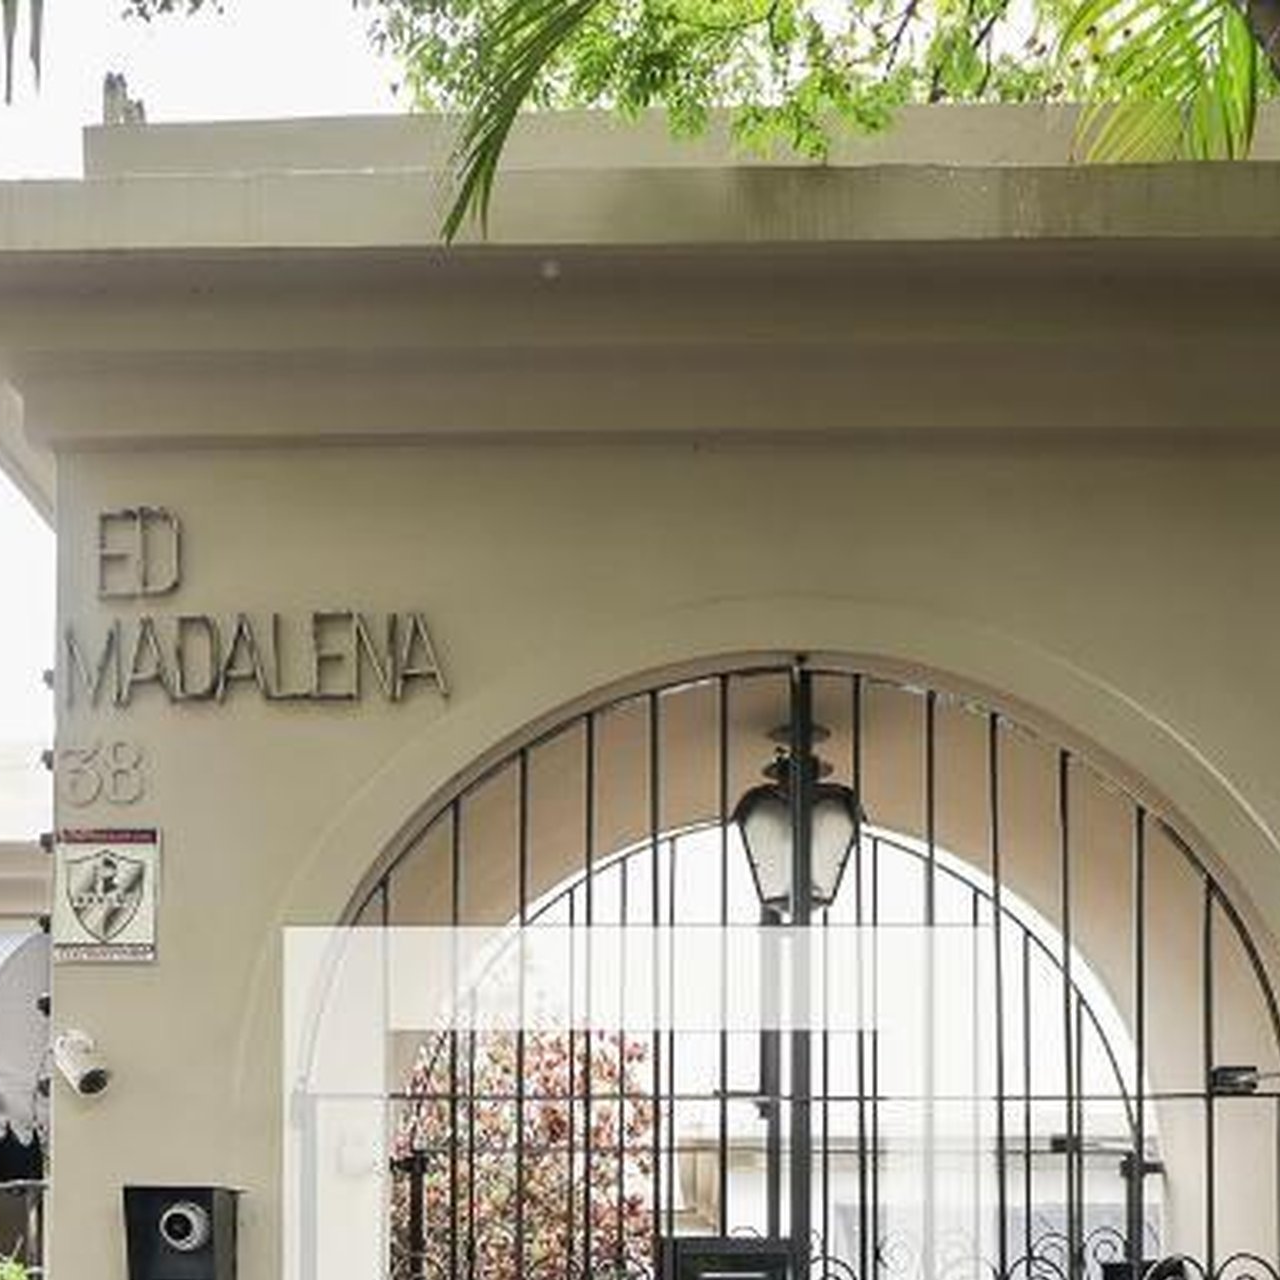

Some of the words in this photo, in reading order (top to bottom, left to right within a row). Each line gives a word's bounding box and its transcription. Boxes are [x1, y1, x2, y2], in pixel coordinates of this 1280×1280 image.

[99, 507, 182, 601] ED
[65, 611, 451, 707] MADALENA
[59, 741, 145, 808] 38
